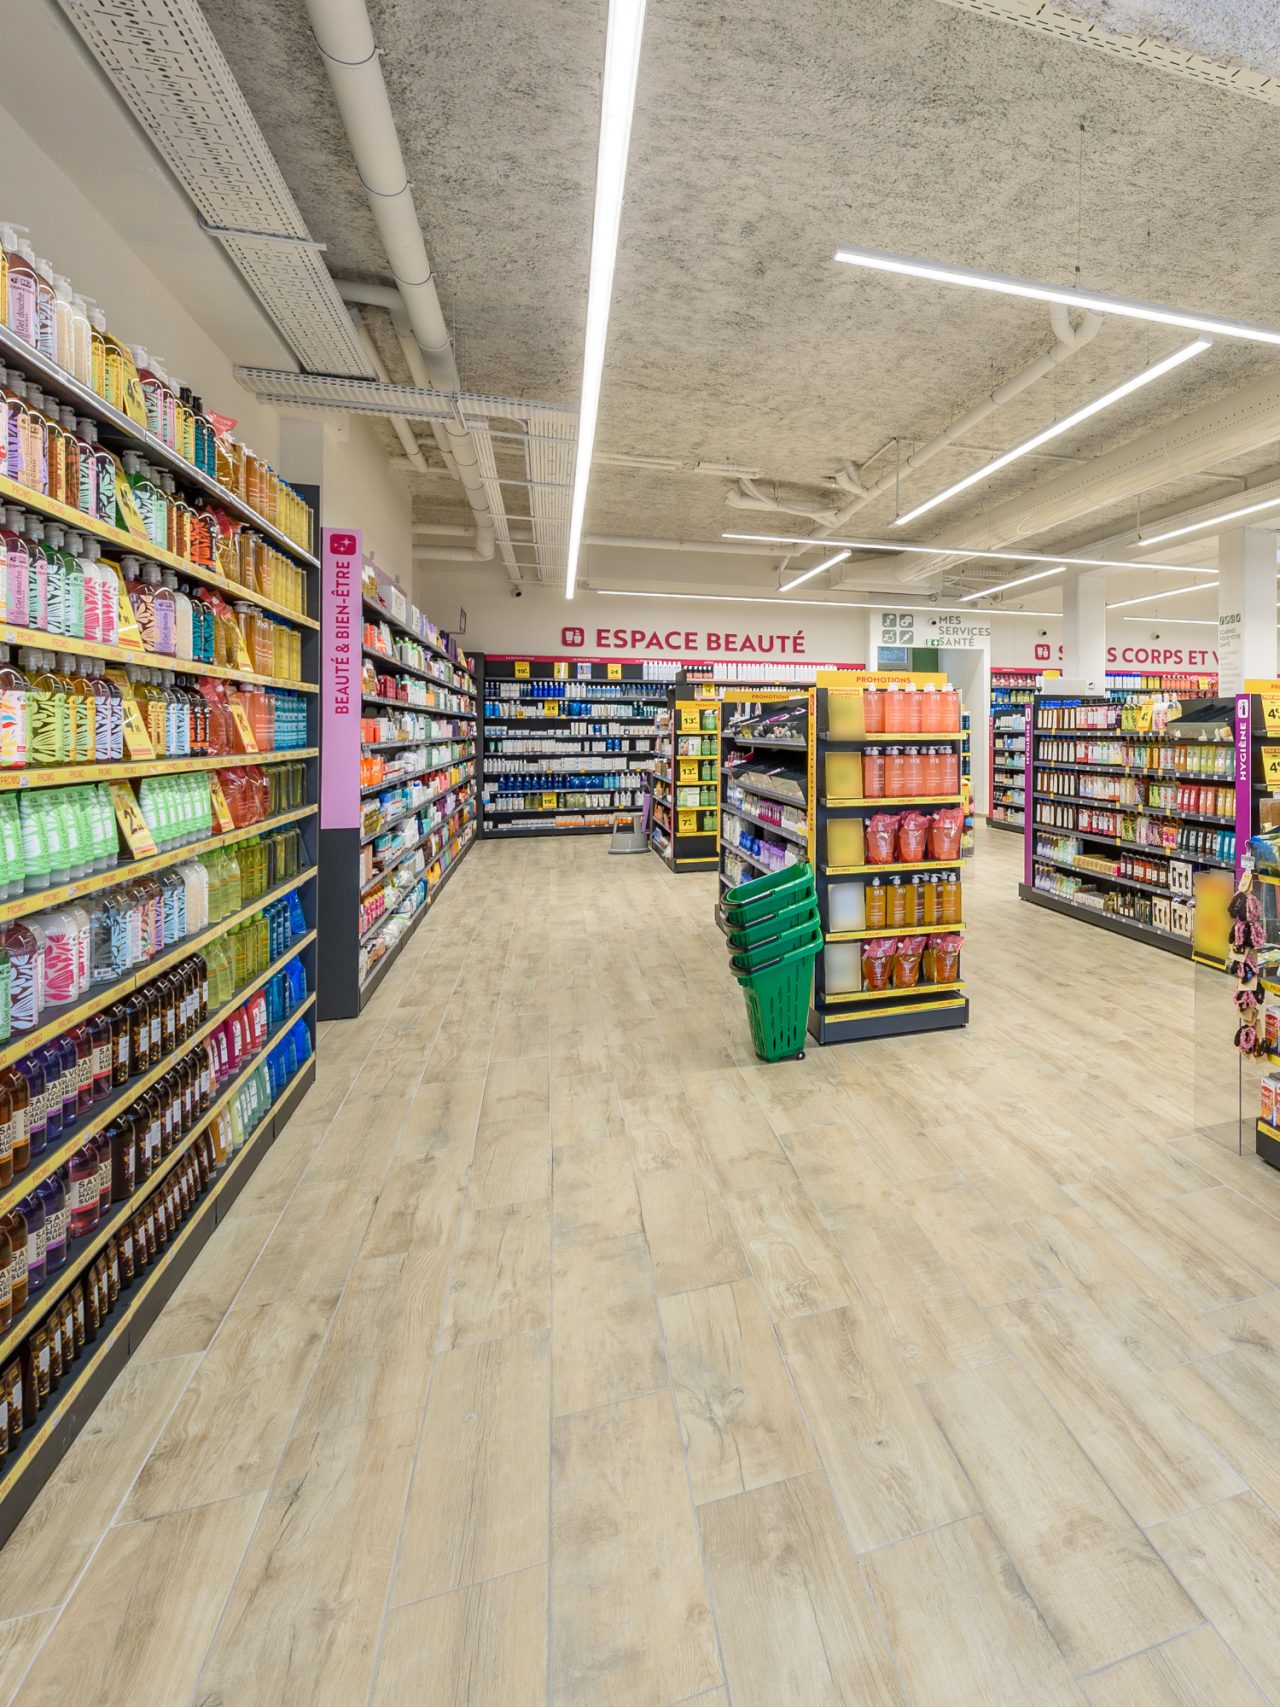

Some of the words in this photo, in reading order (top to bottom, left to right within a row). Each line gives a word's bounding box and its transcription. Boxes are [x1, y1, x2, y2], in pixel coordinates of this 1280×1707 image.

[331, 561, 350, 639] BIEN-ÊTRE
[939, 616, 962, 625] MES
[938, 626, 991, 637] SERVICES
[596, 628, 698, 650] ESPACE
[706, 630, 806, 653] BEAUTÉ
[939, 636, 975, 647] SANTÉ
[335, 644, 350, 654] &
[1122, 648, 1183, 665] CORPS
[1188, 650, 1208, 665] ET
[331, 658, 349, 715] BEAUTÉ
[856, 676, 911, 684] PROMOTIONS
[1239, 722, 1247, 781] HYGIÈNE
